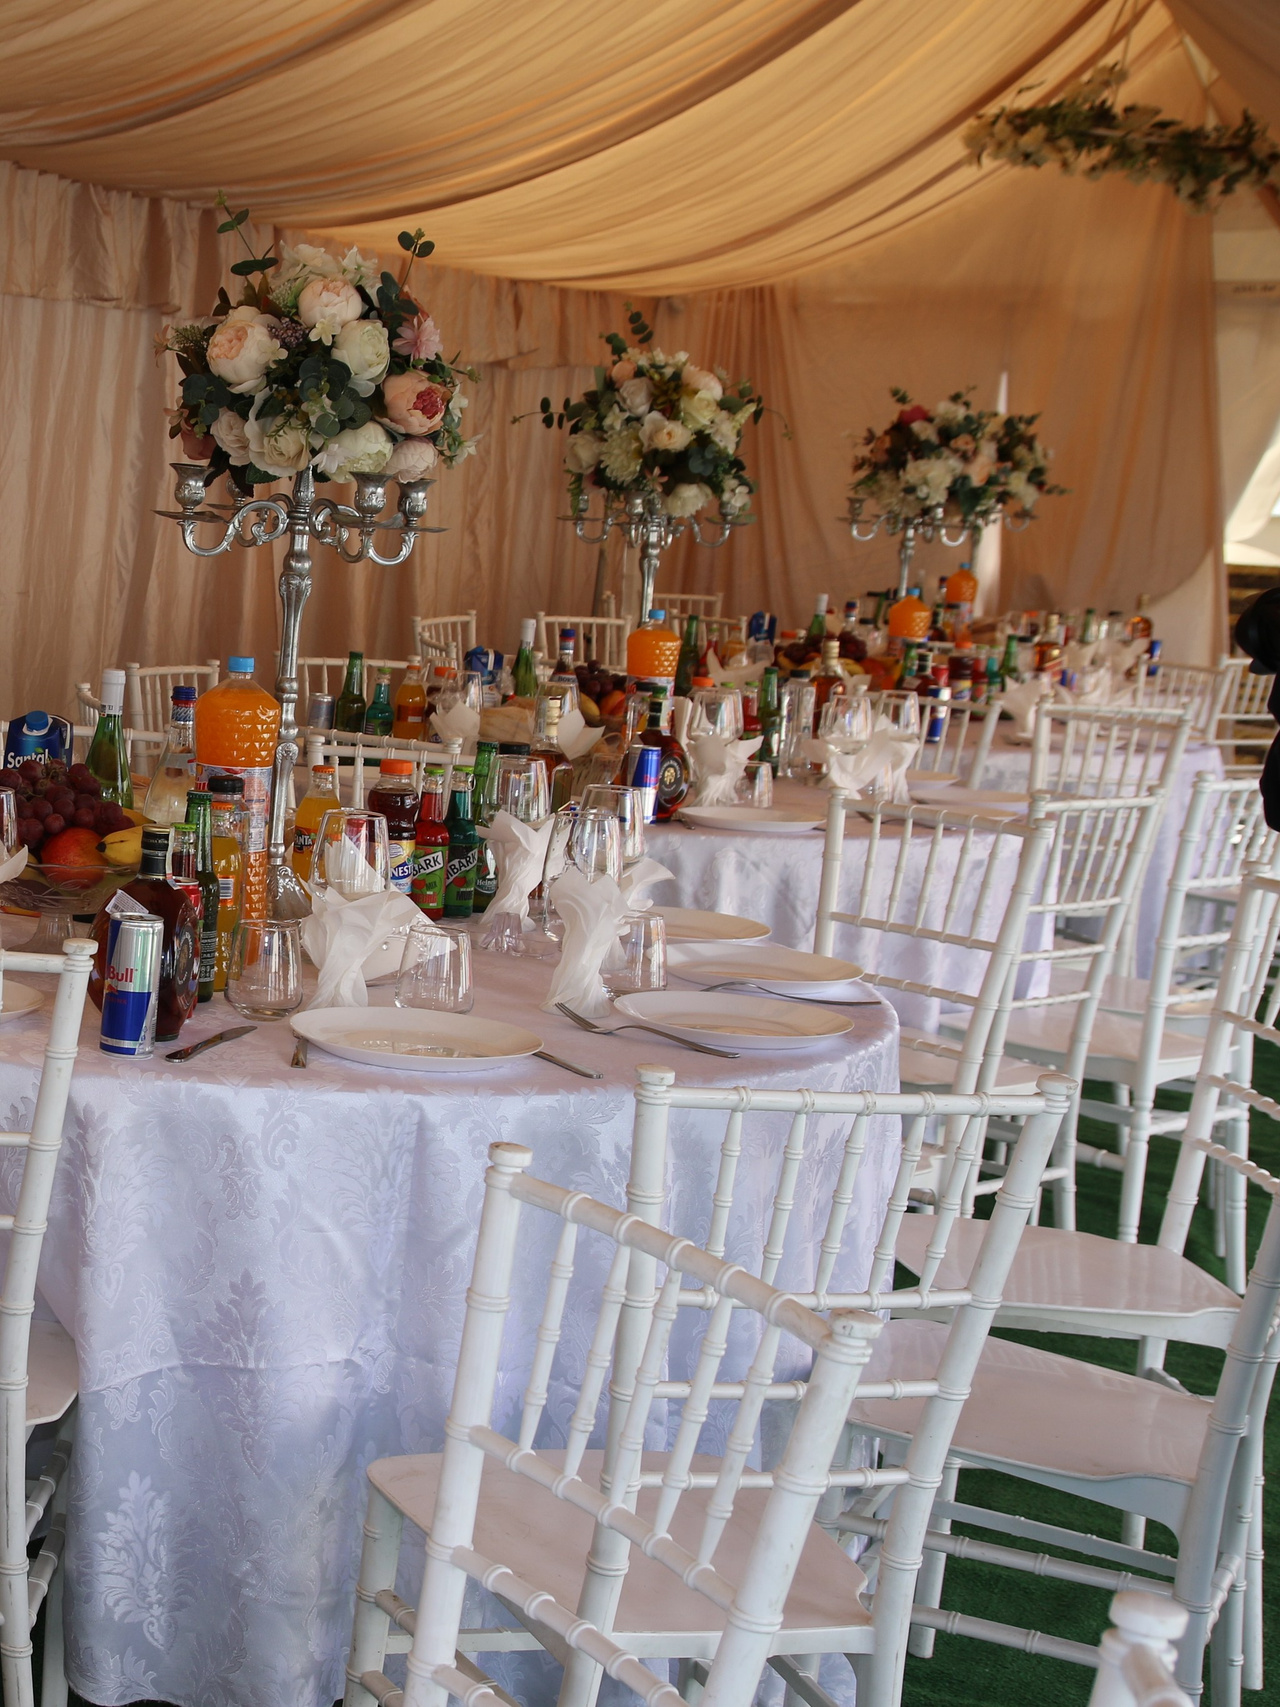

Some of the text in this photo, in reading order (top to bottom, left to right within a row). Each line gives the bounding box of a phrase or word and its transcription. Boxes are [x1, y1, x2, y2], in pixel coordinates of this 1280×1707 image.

[390, 865, 413, 878] NEST
[412, 854, 441, 877] BARK
[446, 852, 477, 880] MBARK
[108, 965, 134, 983] Bull
